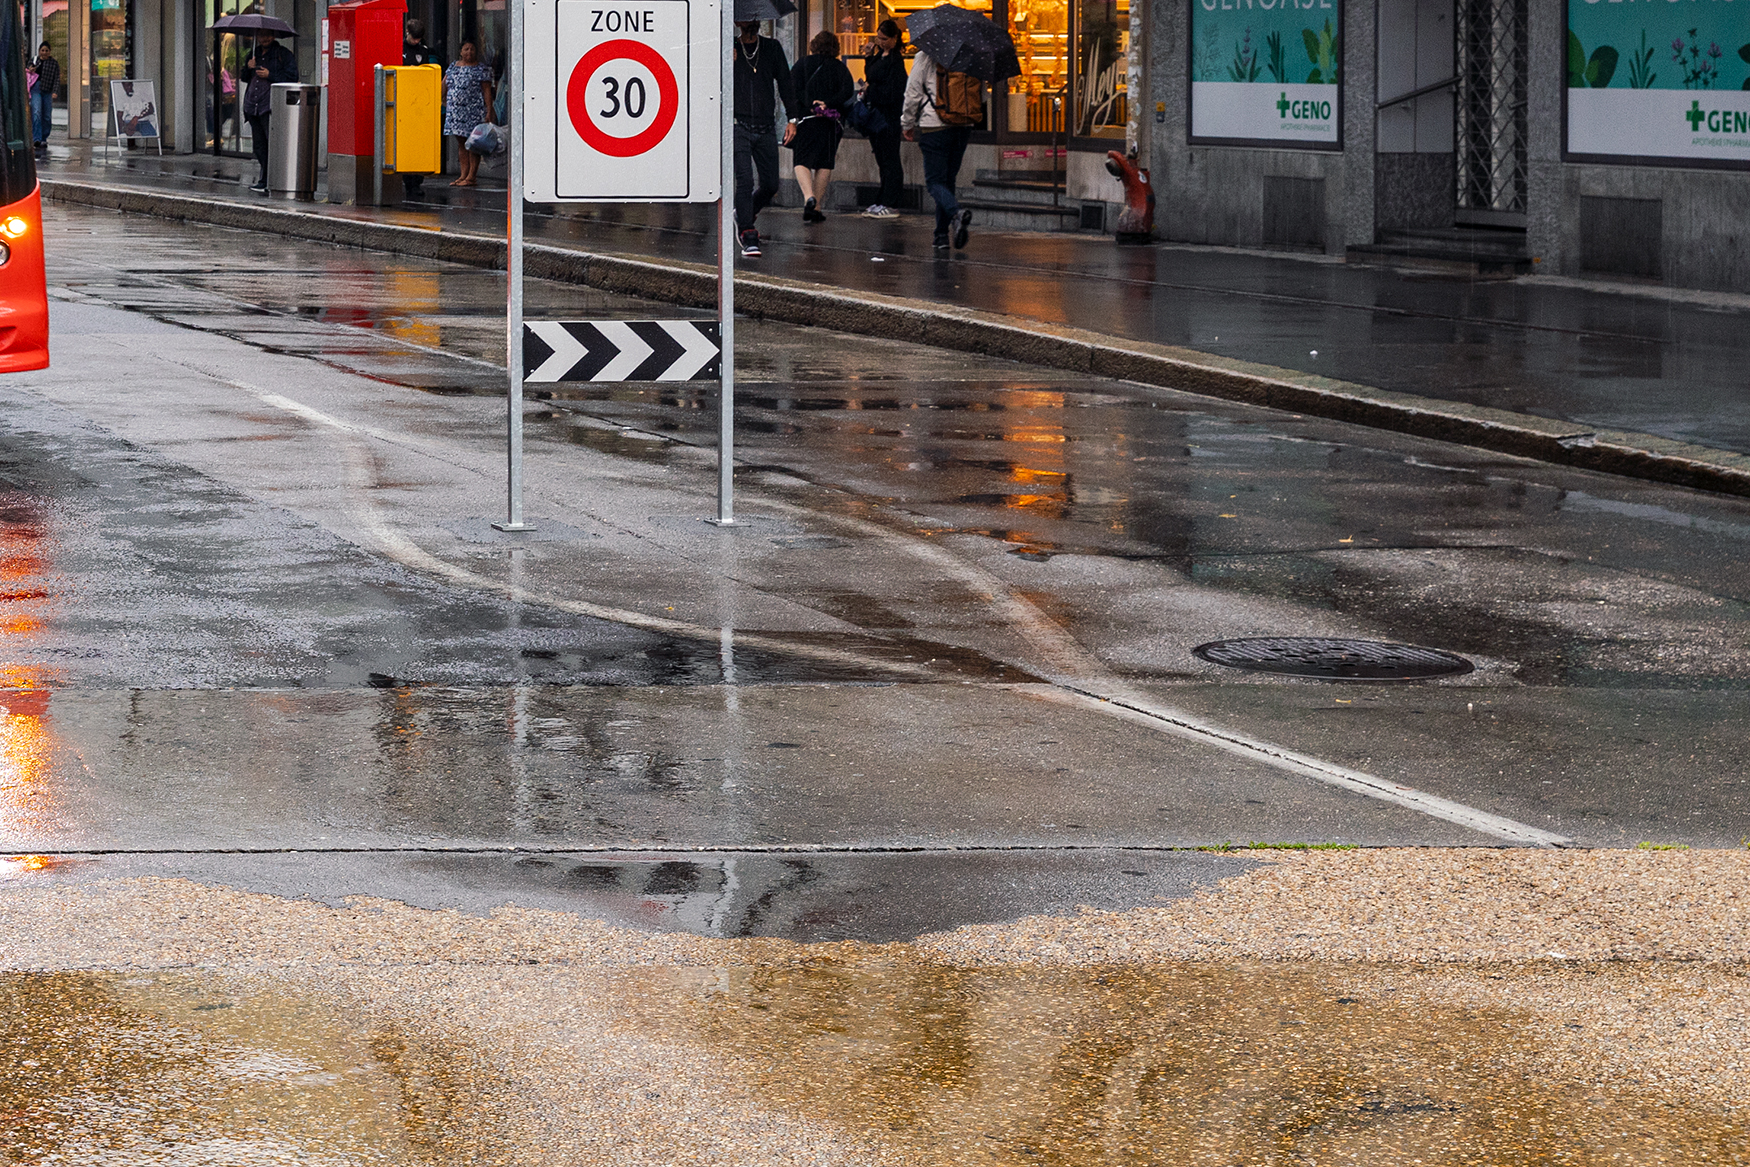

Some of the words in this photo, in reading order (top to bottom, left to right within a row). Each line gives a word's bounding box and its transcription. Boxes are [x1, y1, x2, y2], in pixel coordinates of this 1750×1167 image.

[591, 10, 654, 33] ZONE
[600, 76, 646, 119] 30
[1292, 100, 1331, 120] GENO
[1708, 110, 1750, 133] GEN
